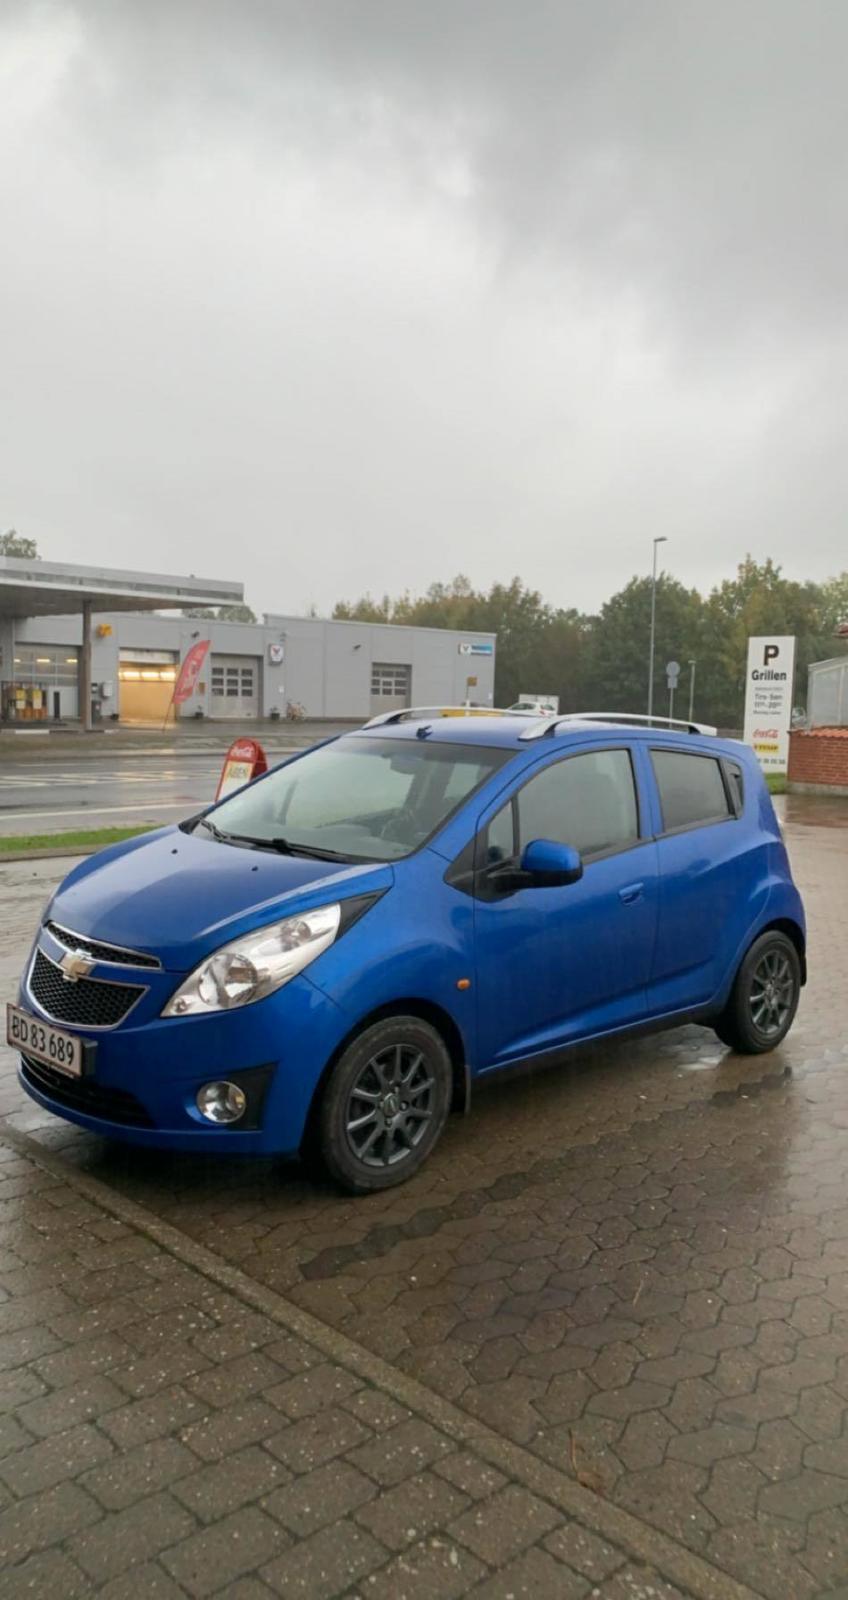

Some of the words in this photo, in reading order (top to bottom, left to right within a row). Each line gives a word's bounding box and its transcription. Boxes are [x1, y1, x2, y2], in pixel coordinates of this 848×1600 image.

[763, 645, 779, 666] P
[751, 670, 787, 681] Grillen
[30, 1024, 46, 1052] 83
[49, 1033, 74, 1066] 689
